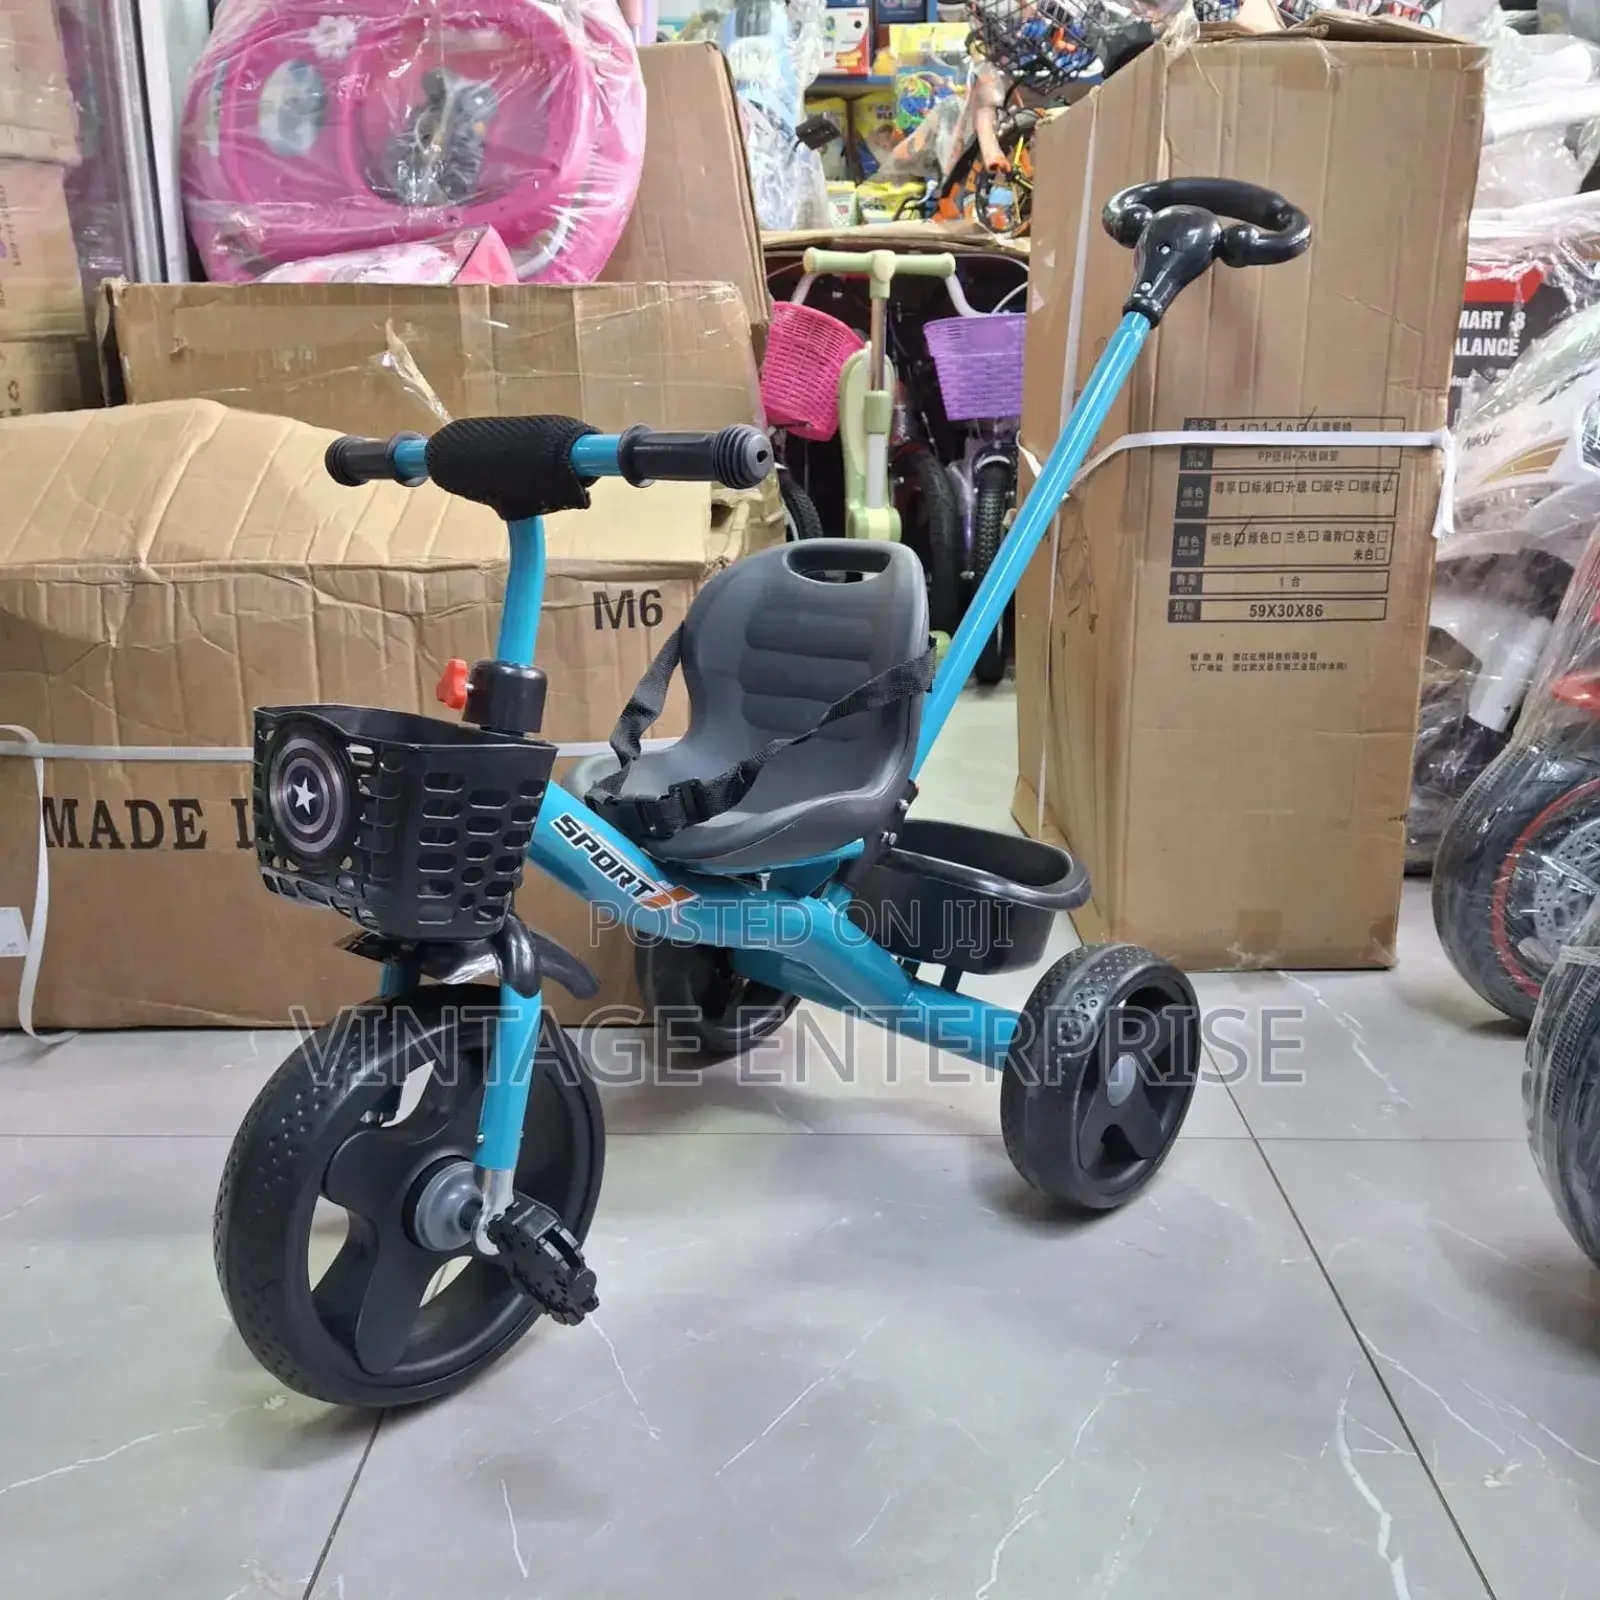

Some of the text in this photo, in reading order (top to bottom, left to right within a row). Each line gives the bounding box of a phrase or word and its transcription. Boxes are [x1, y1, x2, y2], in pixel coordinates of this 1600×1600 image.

[593, 589, 663, 630] M6
[1248, 603, 1324, 619] 59X30X86
[43, 797, 208, 850] MADE
[550, 812, 658, 902] SPORT
